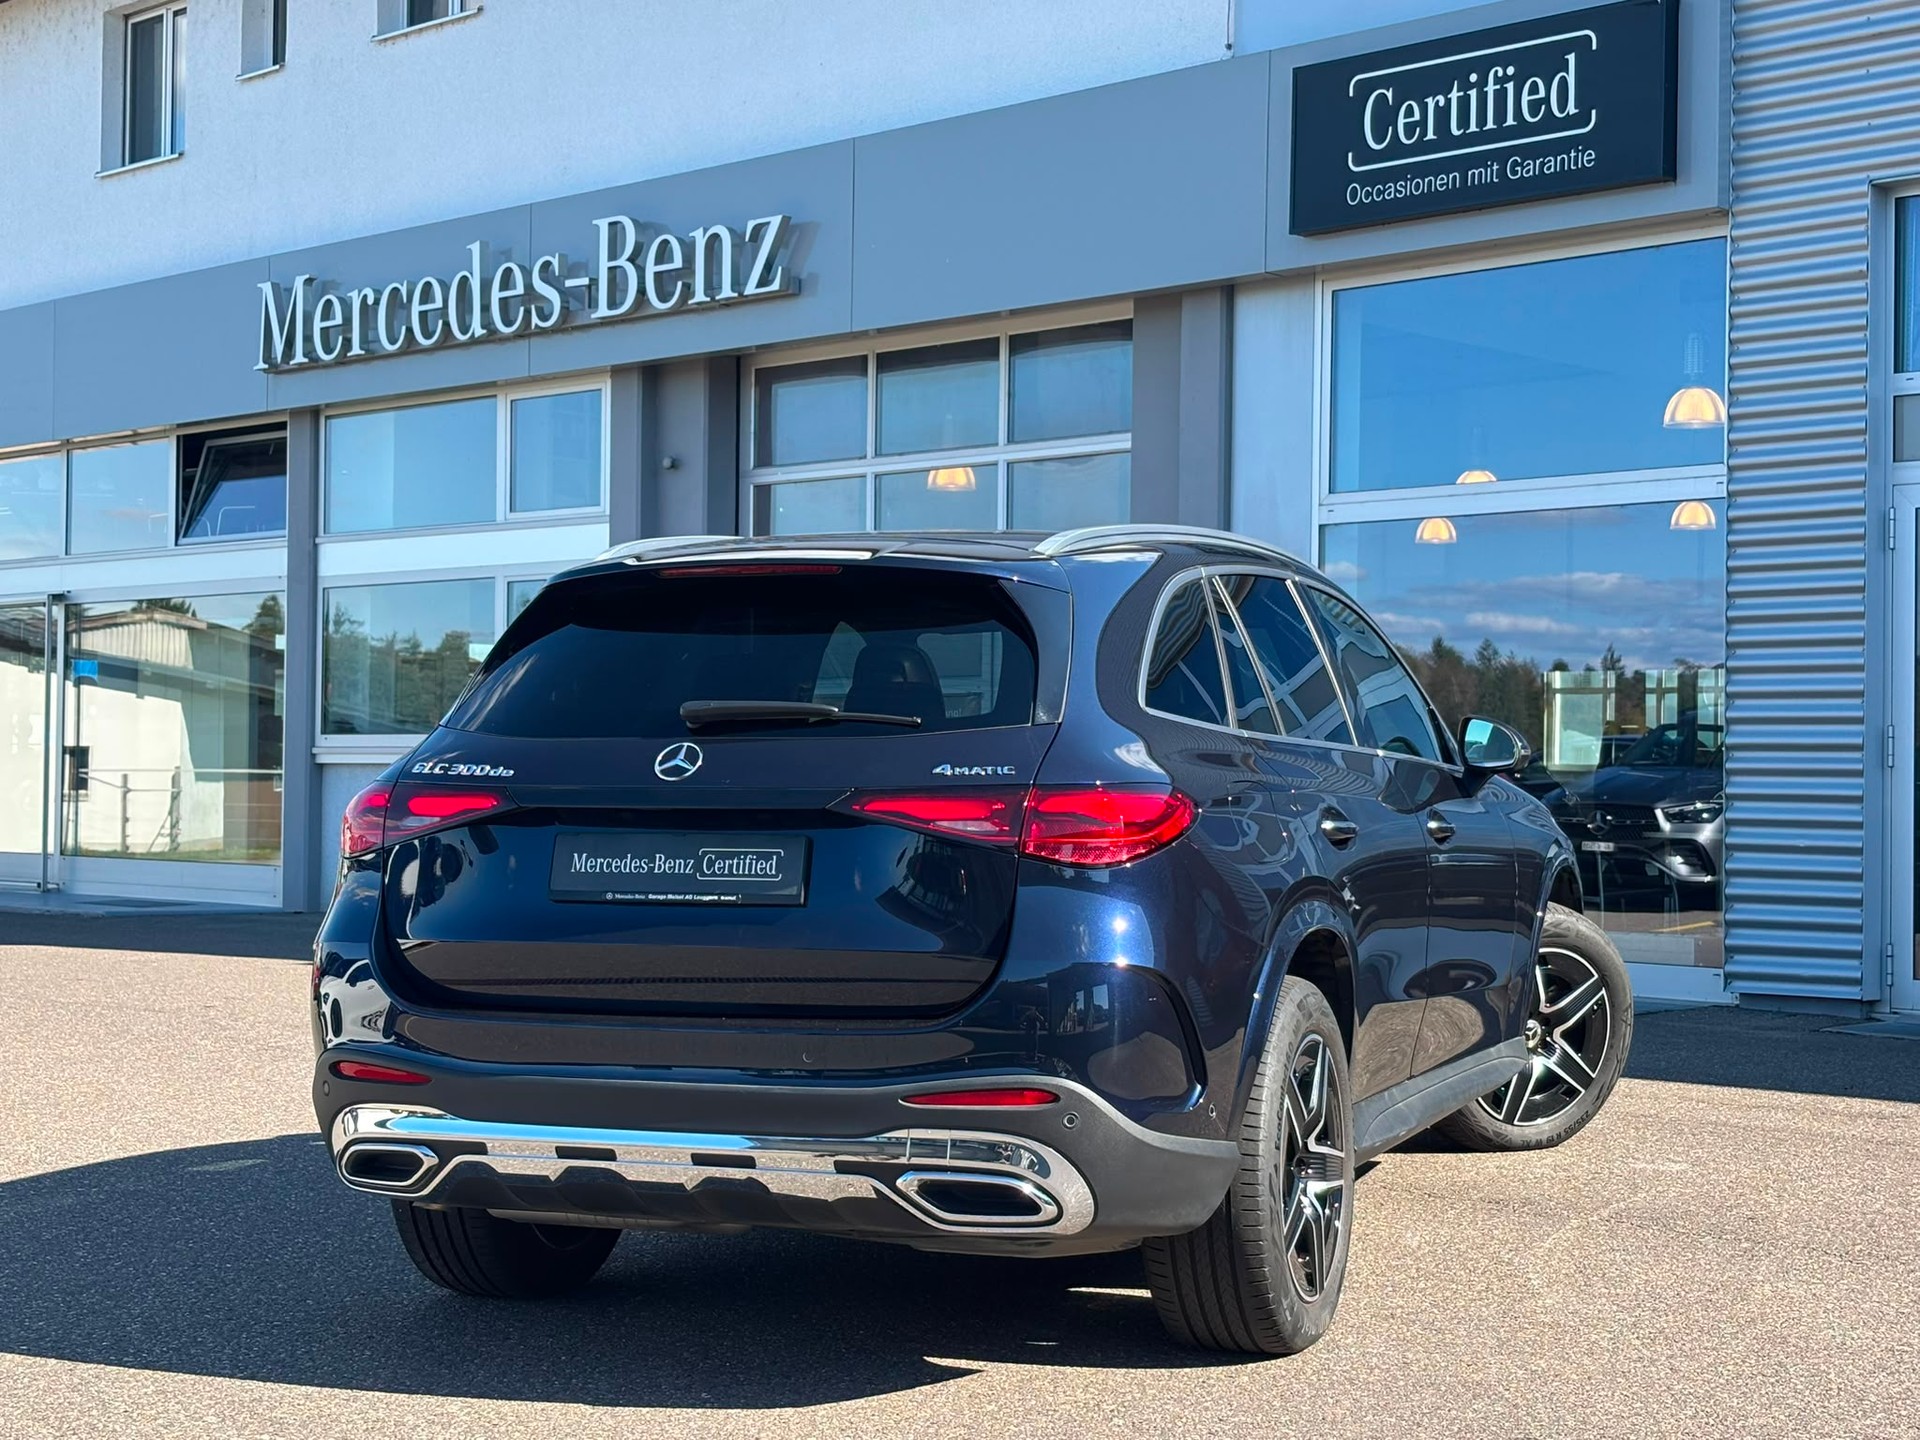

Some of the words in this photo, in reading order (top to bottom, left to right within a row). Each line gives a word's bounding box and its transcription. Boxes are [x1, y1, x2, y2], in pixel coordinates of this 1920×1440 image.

[1363, 51, 1580, 151] Certified
[1345, 172, 1461, 206] Occasionen
[1467, 160, 1500, 187] mit
[1505, 145, 1597, 180] Garantie
[253, 213, 789, 372] Mercedes-Benz
[411, 761, 448, 774] GLC
[931, 763, 1016, 776] 4MATIC
[570, 852, 695, 875] Mercedes-Benz
[702, 853, 778, 876] Certified
[1563, 1109, 1591, 1136] 235/55
